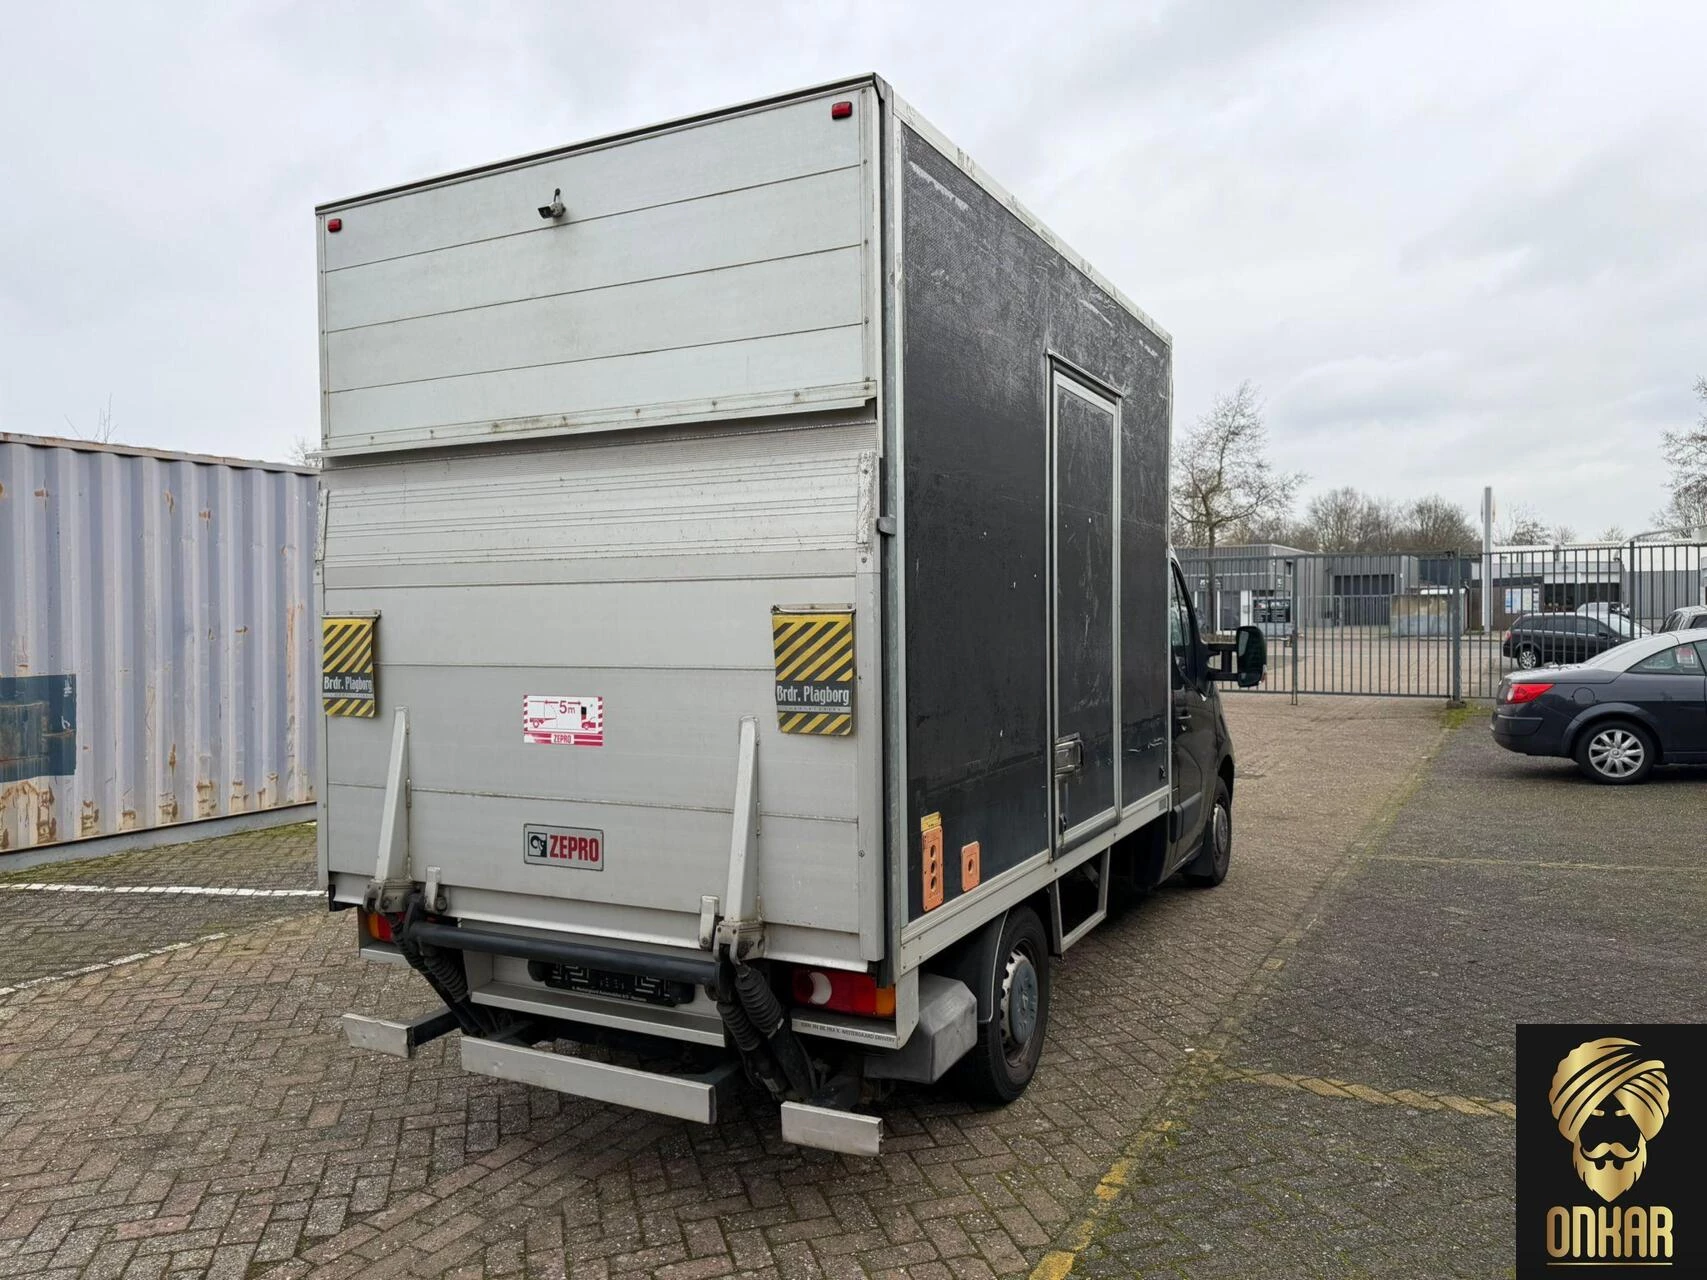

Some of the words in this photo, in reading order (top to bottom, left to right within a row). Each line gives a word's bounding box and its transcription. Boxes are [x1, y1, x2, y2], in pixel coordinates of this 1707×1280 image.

[324, 676, 344, 690] Brdr.
[345, 676, 372, 692] Plagborg
[777, 685, 801, 702] Brdr.
[803, 685, 849, 705] Plagborg
[553, 734, 572, 744] ZEPRO
[549, 834, 600, 863] ZEPRO
